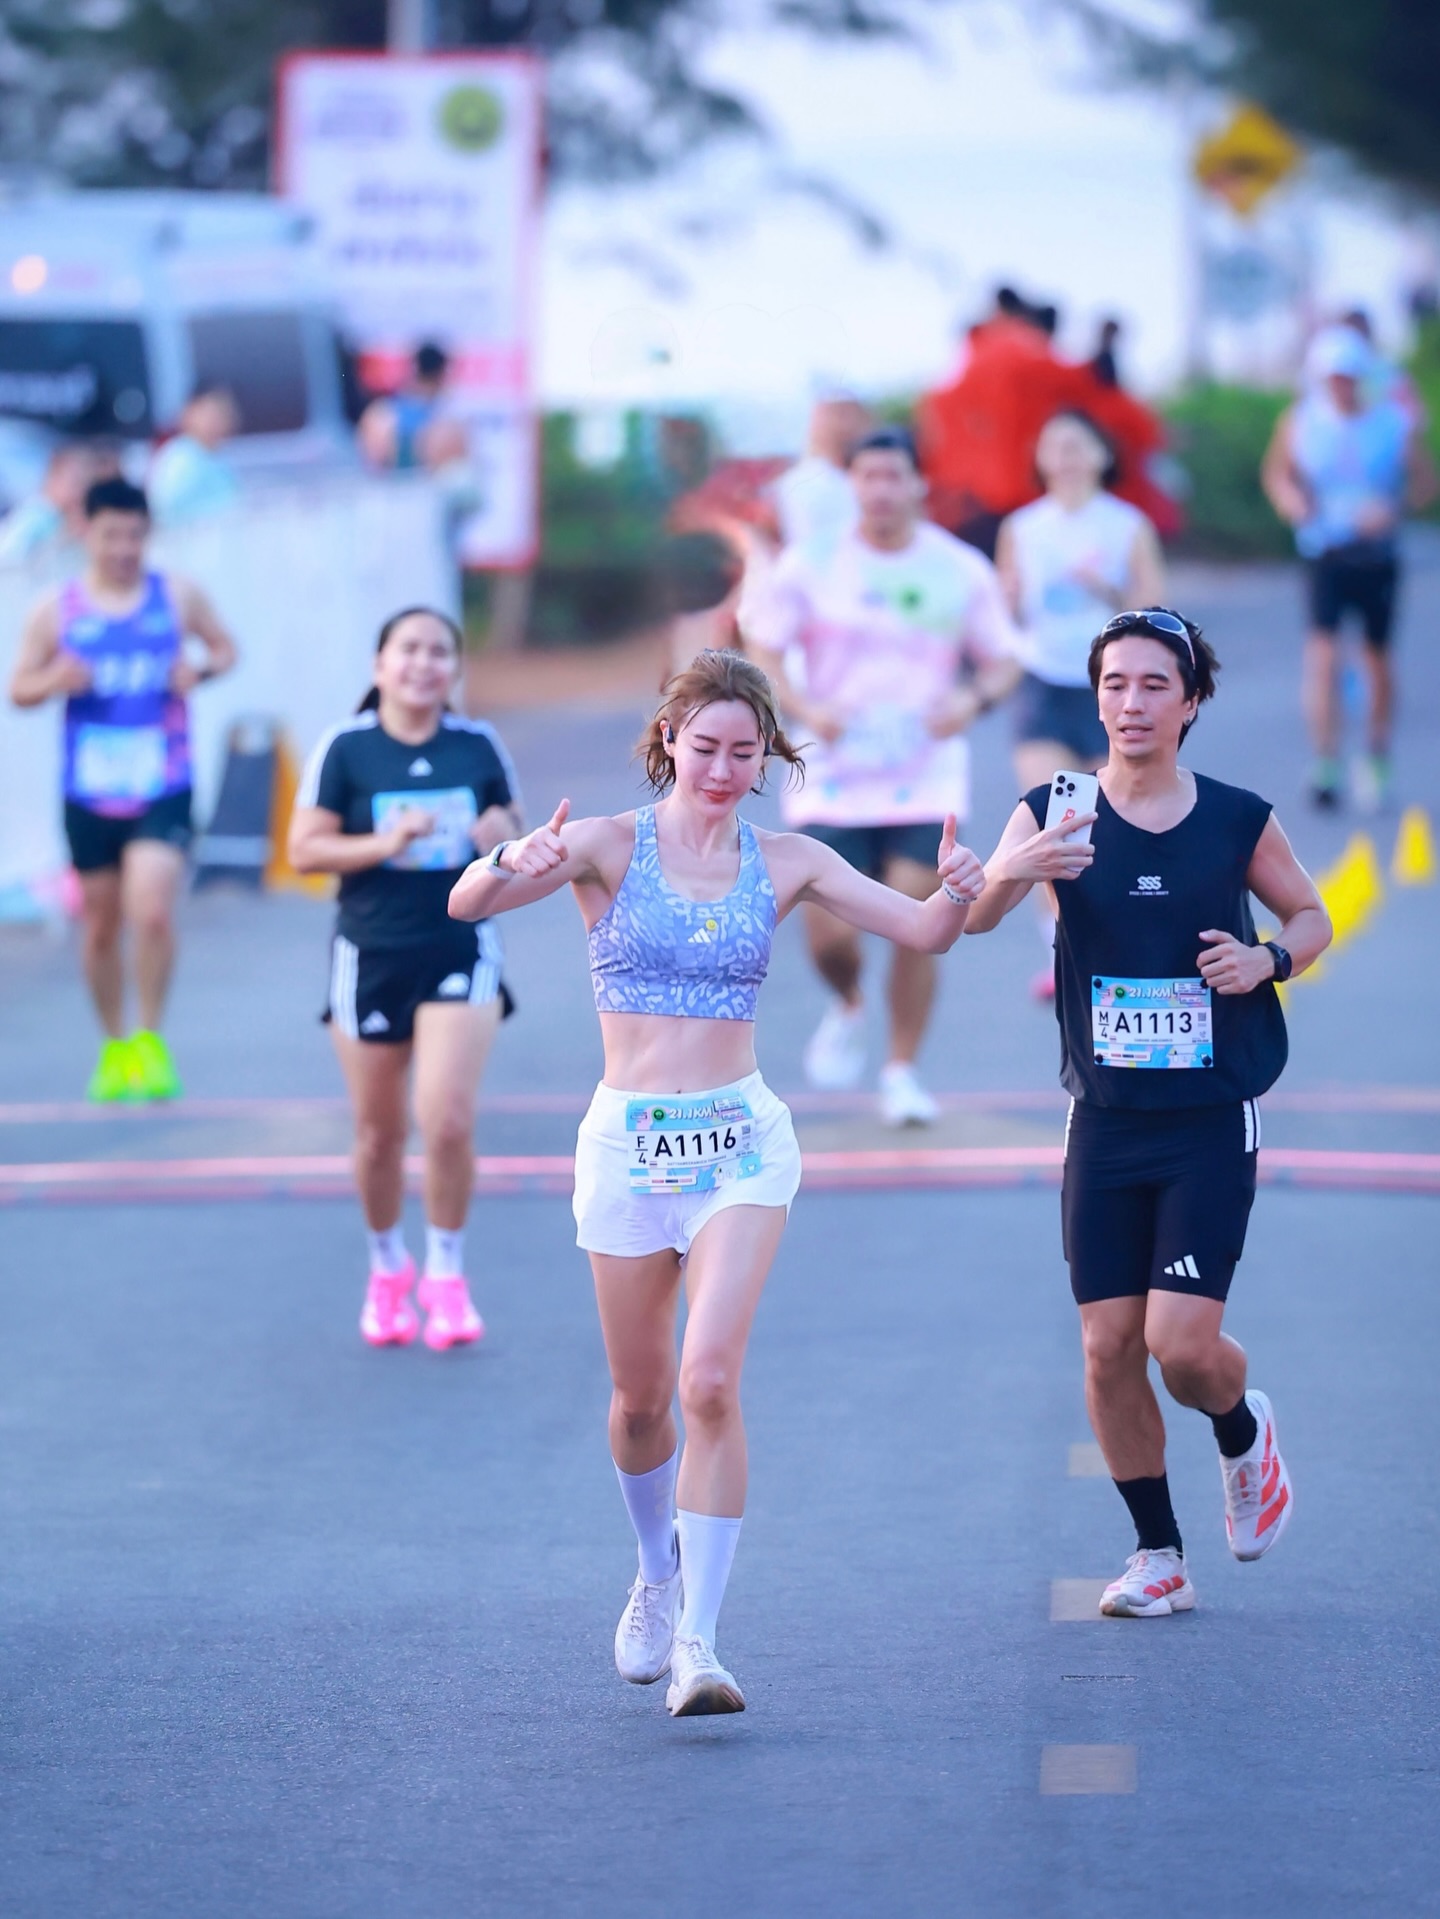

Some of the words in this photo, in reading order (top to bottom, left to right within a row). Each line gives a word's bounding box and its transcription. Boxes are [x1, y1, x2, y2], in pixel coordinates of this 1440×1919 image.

[1129, 987, 1171, 998] 21.1KM
[1099, 1011, 1109, 1023] M
[1114, 1011, 1192, 1034] A1113
[1101, 1026, 1108, 1038] 4
[668, 1105, 714, 1120] 21.1KM
[637, 1135, 645, 1148] F
[654, 1127, 736, 1157] A1116
[638, 1152, 646, 1165] 4
